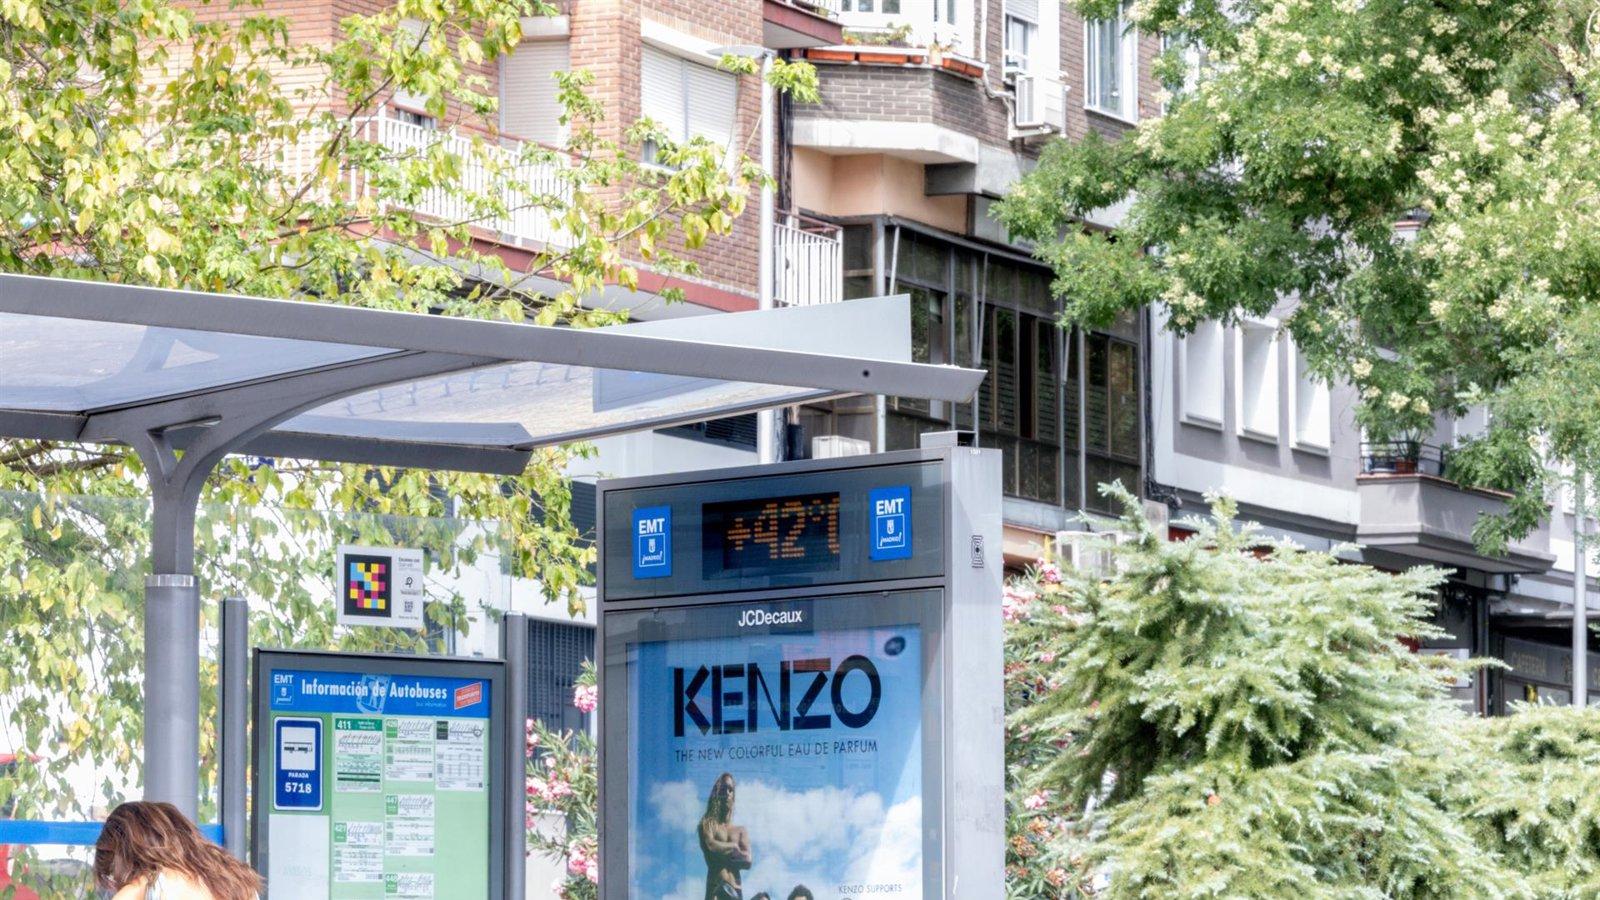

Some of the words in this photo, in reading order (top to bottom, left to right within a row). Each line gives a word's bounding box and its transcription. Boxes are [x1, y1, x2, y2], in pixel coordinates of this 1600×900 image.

[876, 498, 904, 515] EMT
[638, 518, 665, 534] EMT
[738, 609, 803, 627] JCDecaux
[274, 674, 294, 684] EMT
[301, 678, 368, 697] Información
[372, 680, 386, 697] de
[389, 682, 448, 699] Autobuses
[673, 654, 882, 738] KENZO
[337, 720, 352, 729] 411
[675, 749, 694, 763] THE
[698, 748, 724, 761] NEW
[728, 744, 785, 759] COLORFUL
[788, 742, 811, 757] EAU
[815, 741, 829, 755] DE
[833, 739, 878, 754] PARFUM
[285, 781, 312, 794] 5718
[838, 884, 864, 893] KENZO
[867, 883, 902, 893] SUPPORTS
